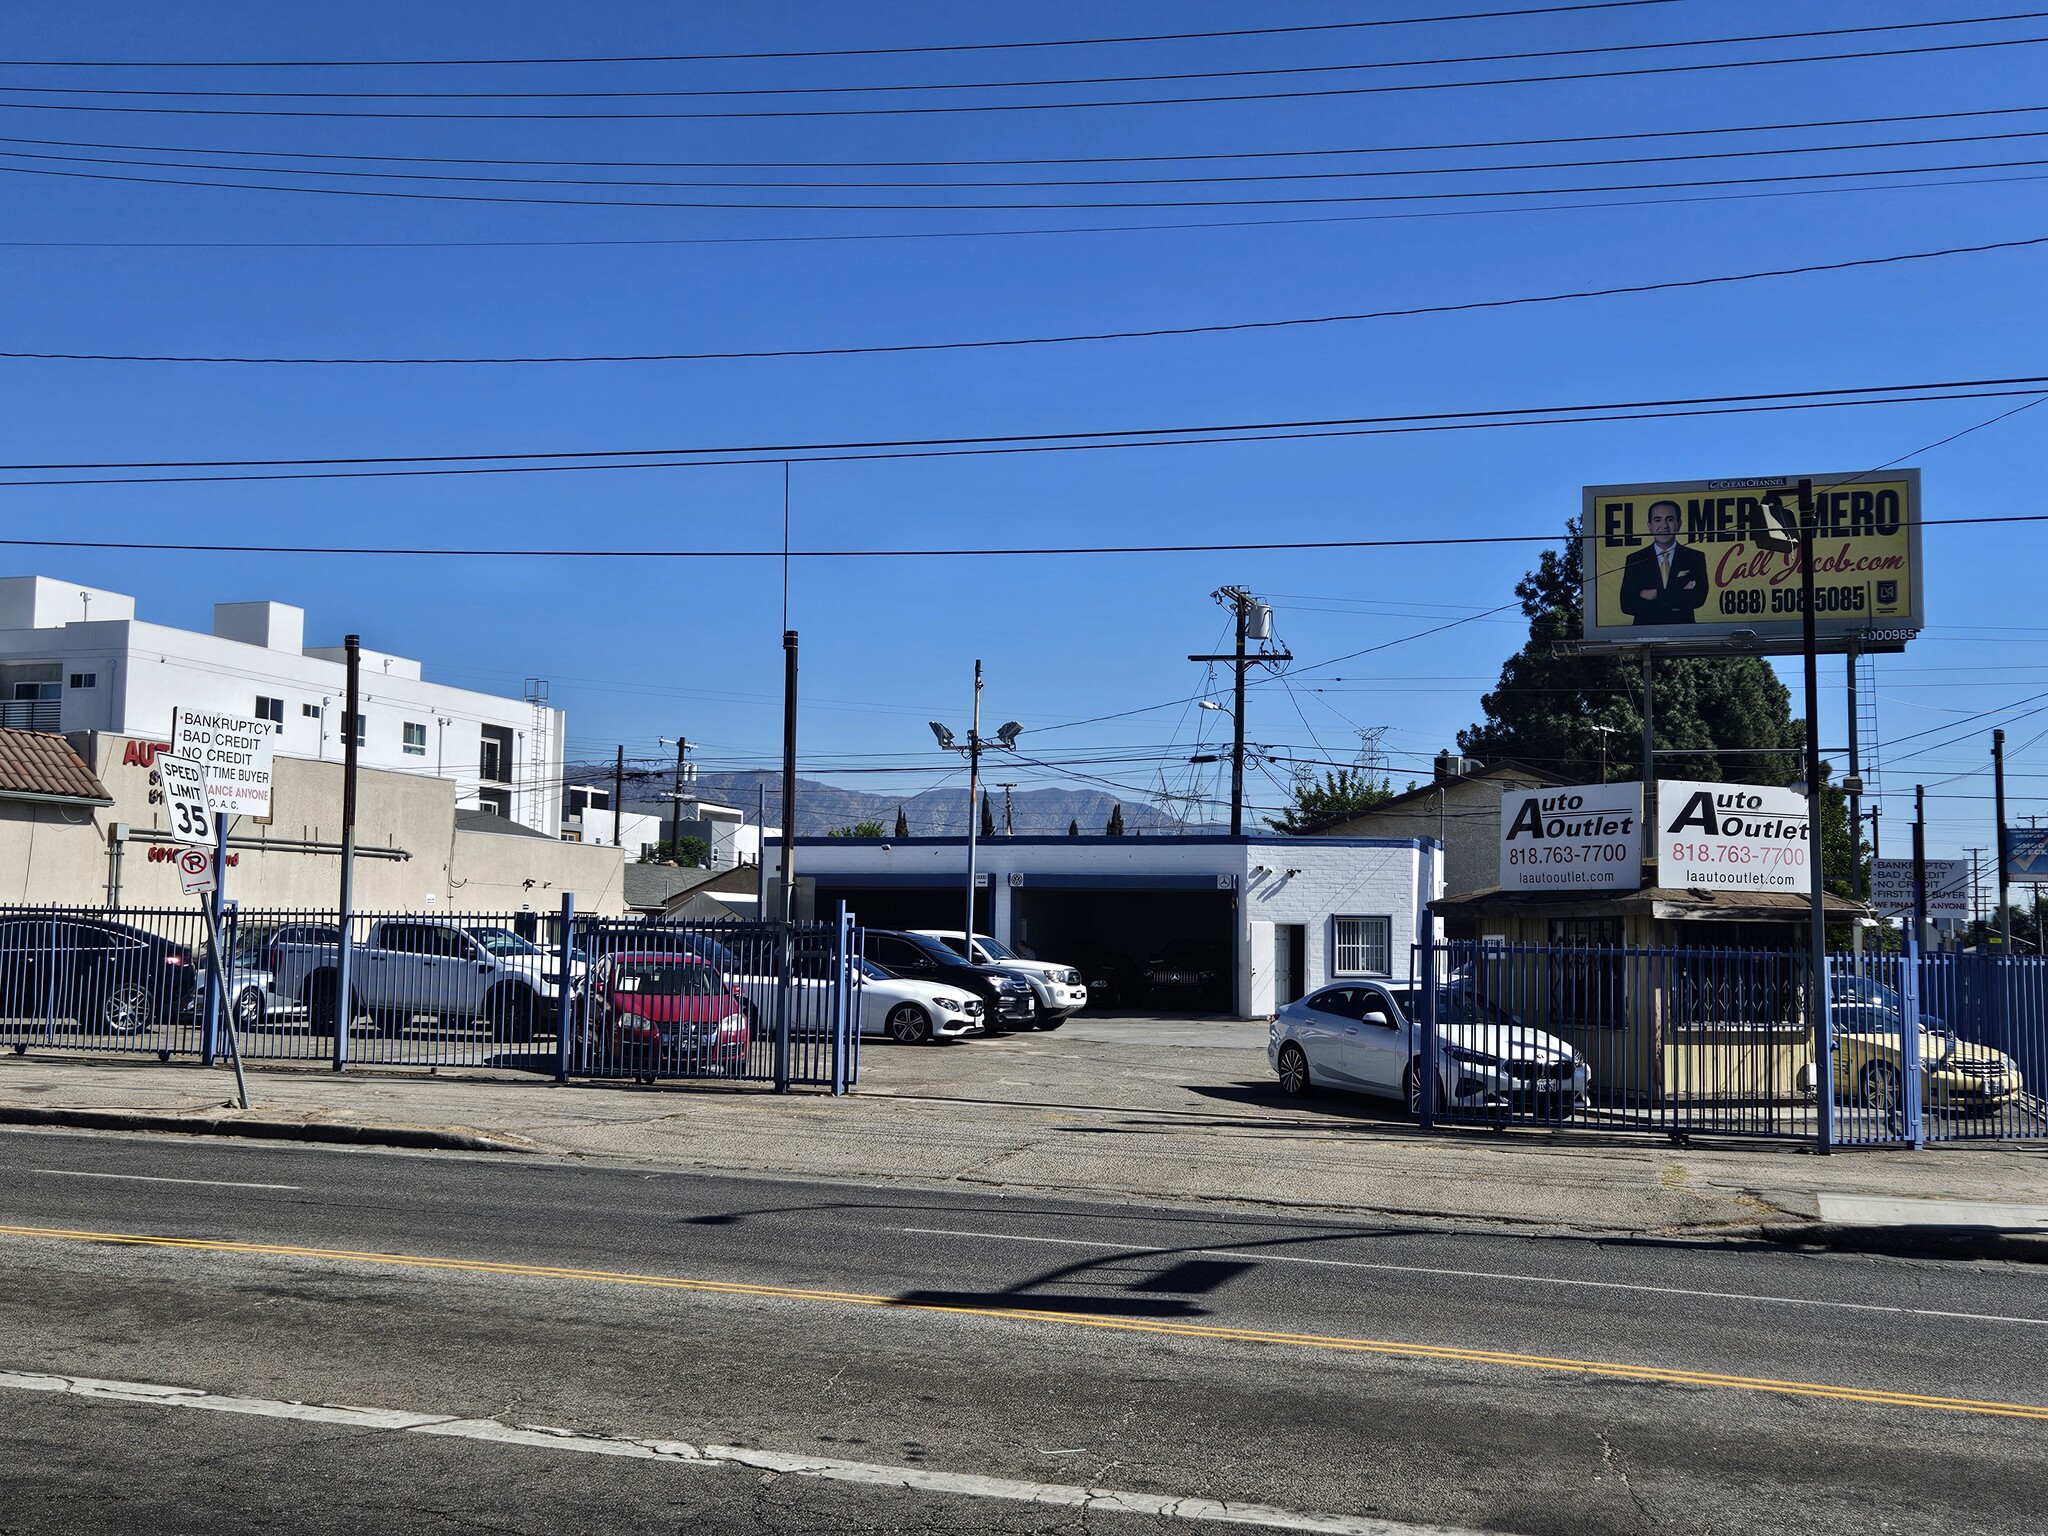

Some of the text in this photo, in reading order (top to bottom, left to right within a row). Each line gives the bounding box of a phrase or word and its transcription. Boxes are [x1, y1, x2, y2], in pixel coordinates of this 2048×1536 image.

[1605, 502, 1642, 547] EL
[1688, 495, 1783, 543] MER
[1715, 543, 1906, 588] Call Jcob.com
[1719, 589, 1767, 616] (888)
[184, 712, 271, 736] BANKRUPTCY
[183, 729, 261, 752] BAD CREDIT
[182, 746, 253, 767] NO CREDIT
[164, 762, 199, 782] SPEED
[212, 766, 236, 780] TIME
[238, 769, 269, 784] BUYER
[168, 782, 201, 801] LIMIT
[206, 784, 269, 801] ANCE ANYONE
[175, 802, 209, 837] 35
[1506, 793, 1584, 841] Auto
[1666, 791, 1763, 836] Auto
[1546, 816, 1634, 839] Outlet
[1721, 816, 1810, 841] Outlet
[1509, 843, 1627, 865] 818.763-7700
[1672, 842, 1805, 866] 818.763-7700
[1519, 871, 1615, 884] laautooutlet.com
[1686, 869, 1795, 885] laautooutlet.com
[1877, 871, 1901, 879] BAD
[1877, 880, 1940, 888] NO CRDIT
[1877, 890, 1903, 898] FIRST
[1930, 902, 1967, 910] ANYONE
